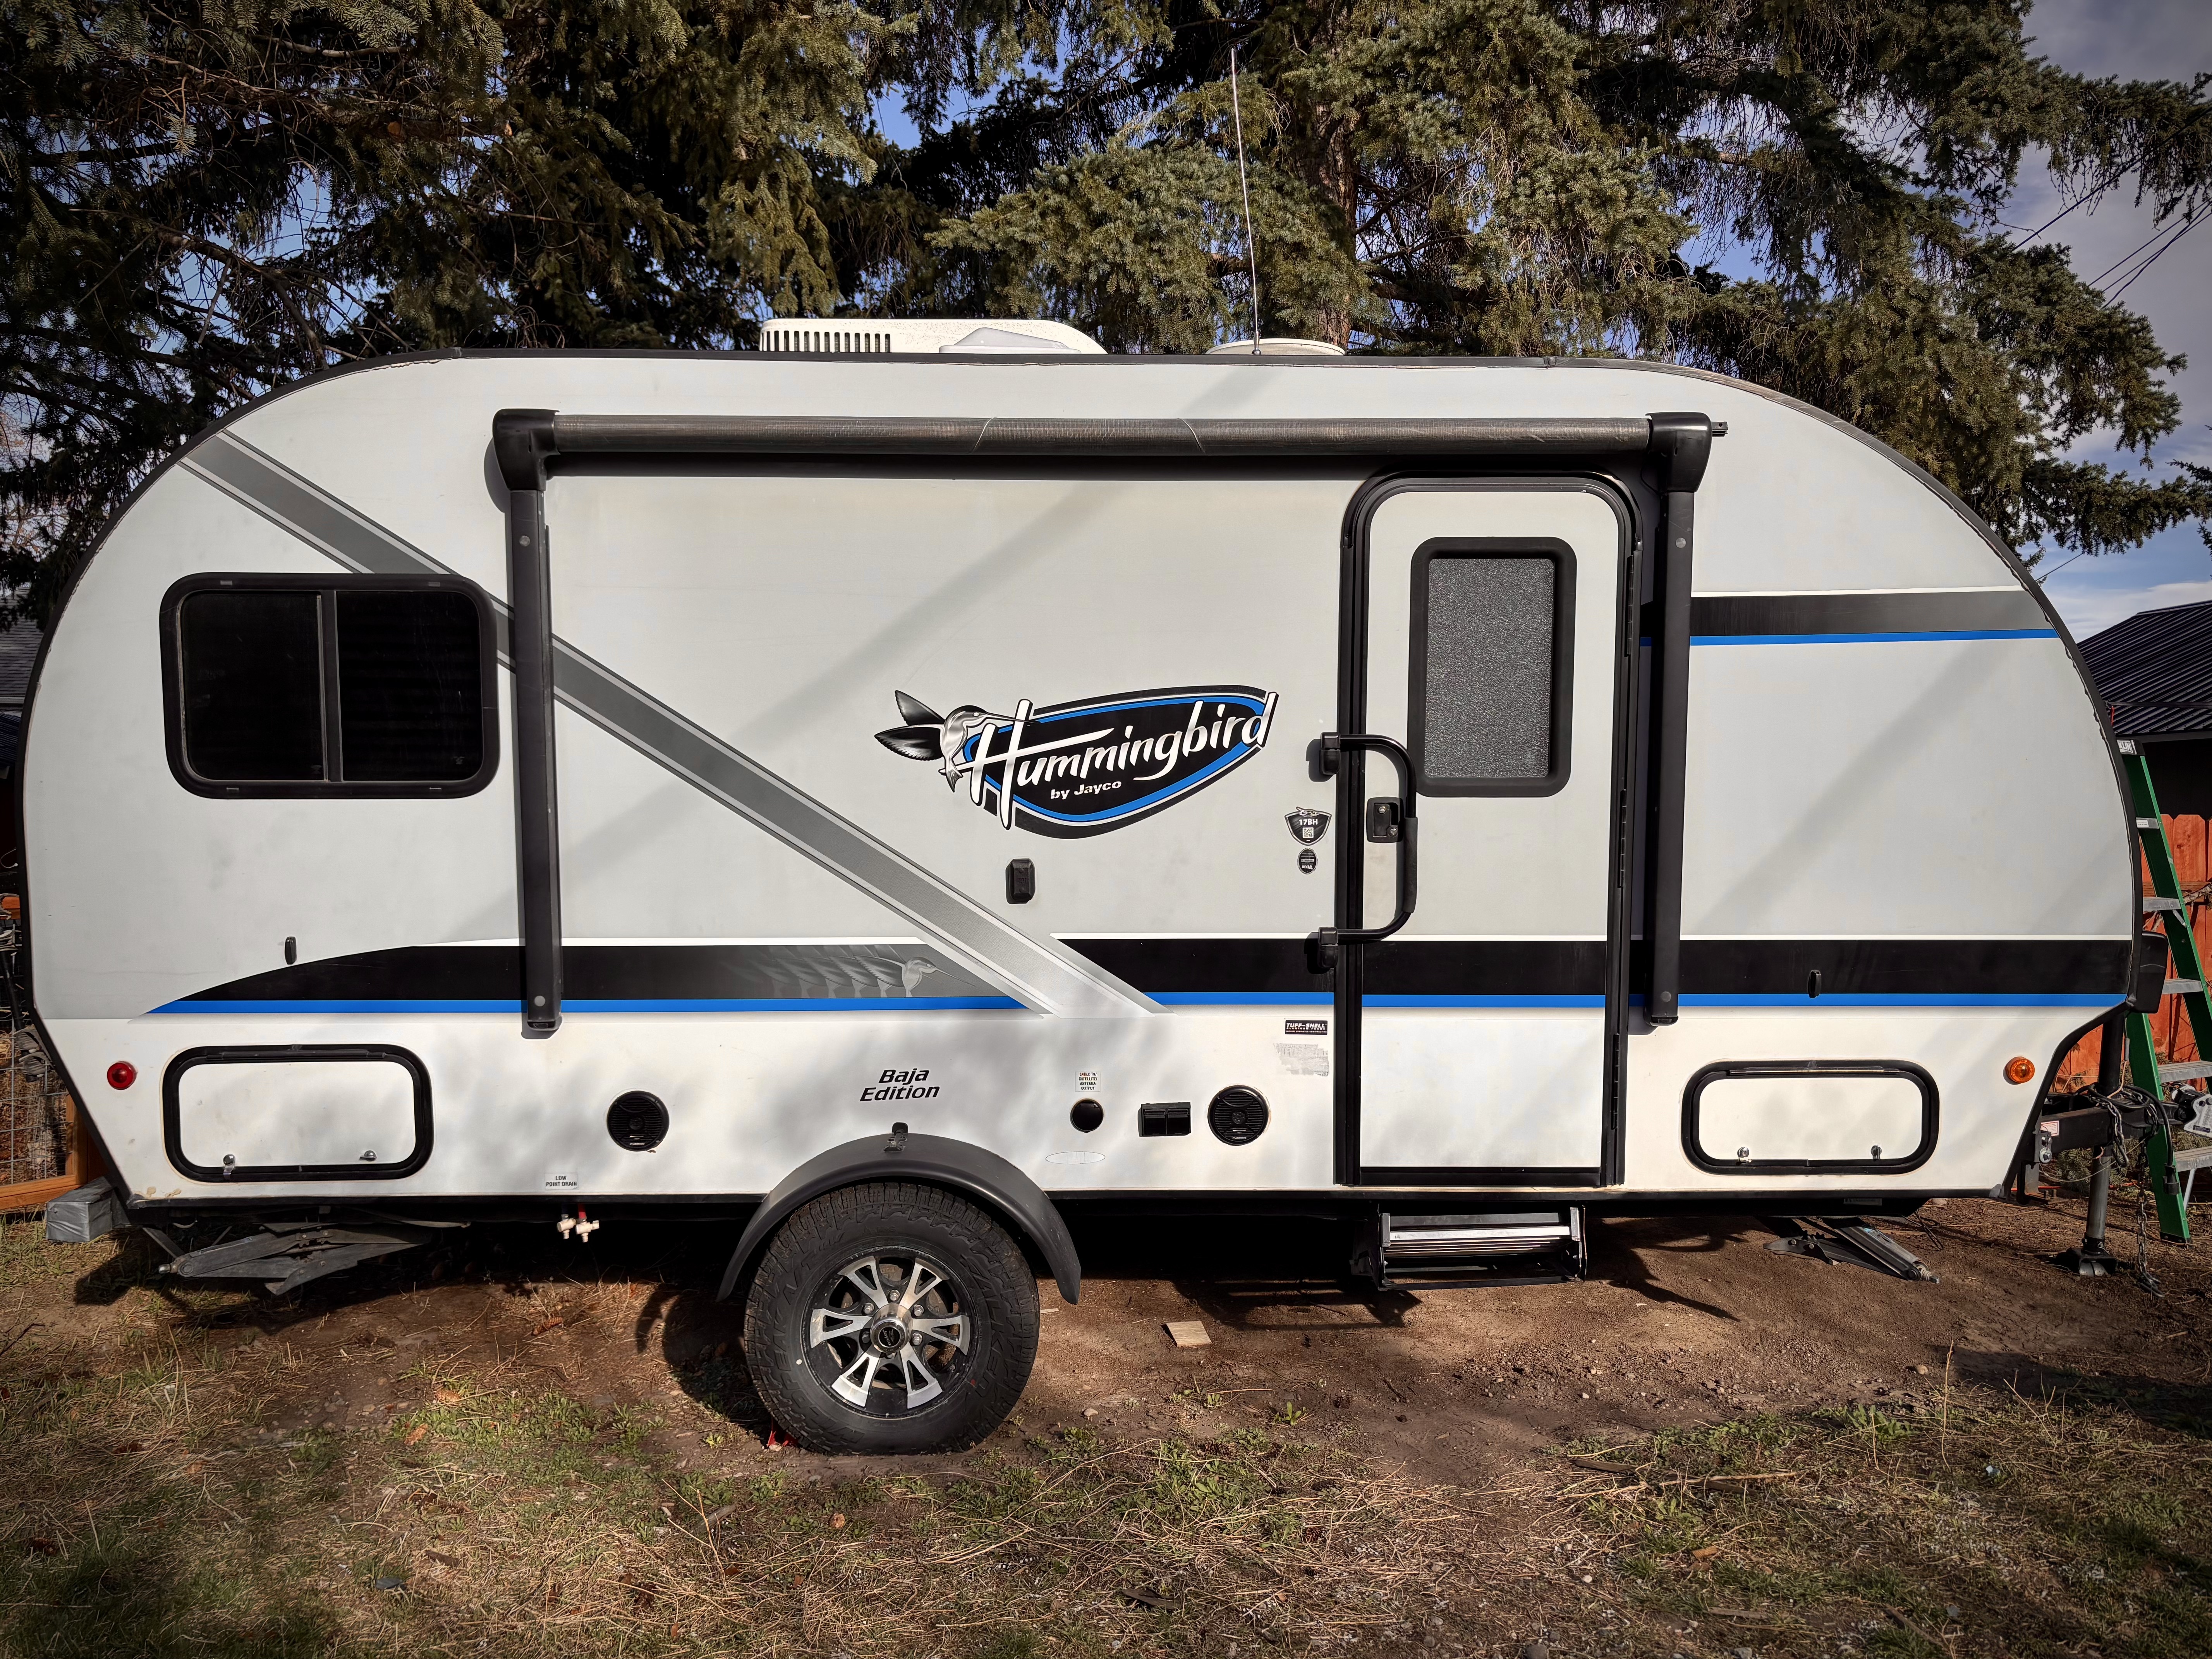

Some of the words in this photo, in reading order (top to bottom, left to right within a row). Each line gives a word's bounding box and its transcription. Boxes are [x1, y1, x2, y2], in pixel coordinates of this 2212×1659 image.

[939, 692, 1279, 830] Hummingbird
[1051, 789, 1070, 800] by
[1074, 781, 1121, 794] Jayco
[878, 1068, 929, 1085] Baja
[860, 1085, 940, 1101] Edition
[883, 1329, 891, 1346] Jayco
